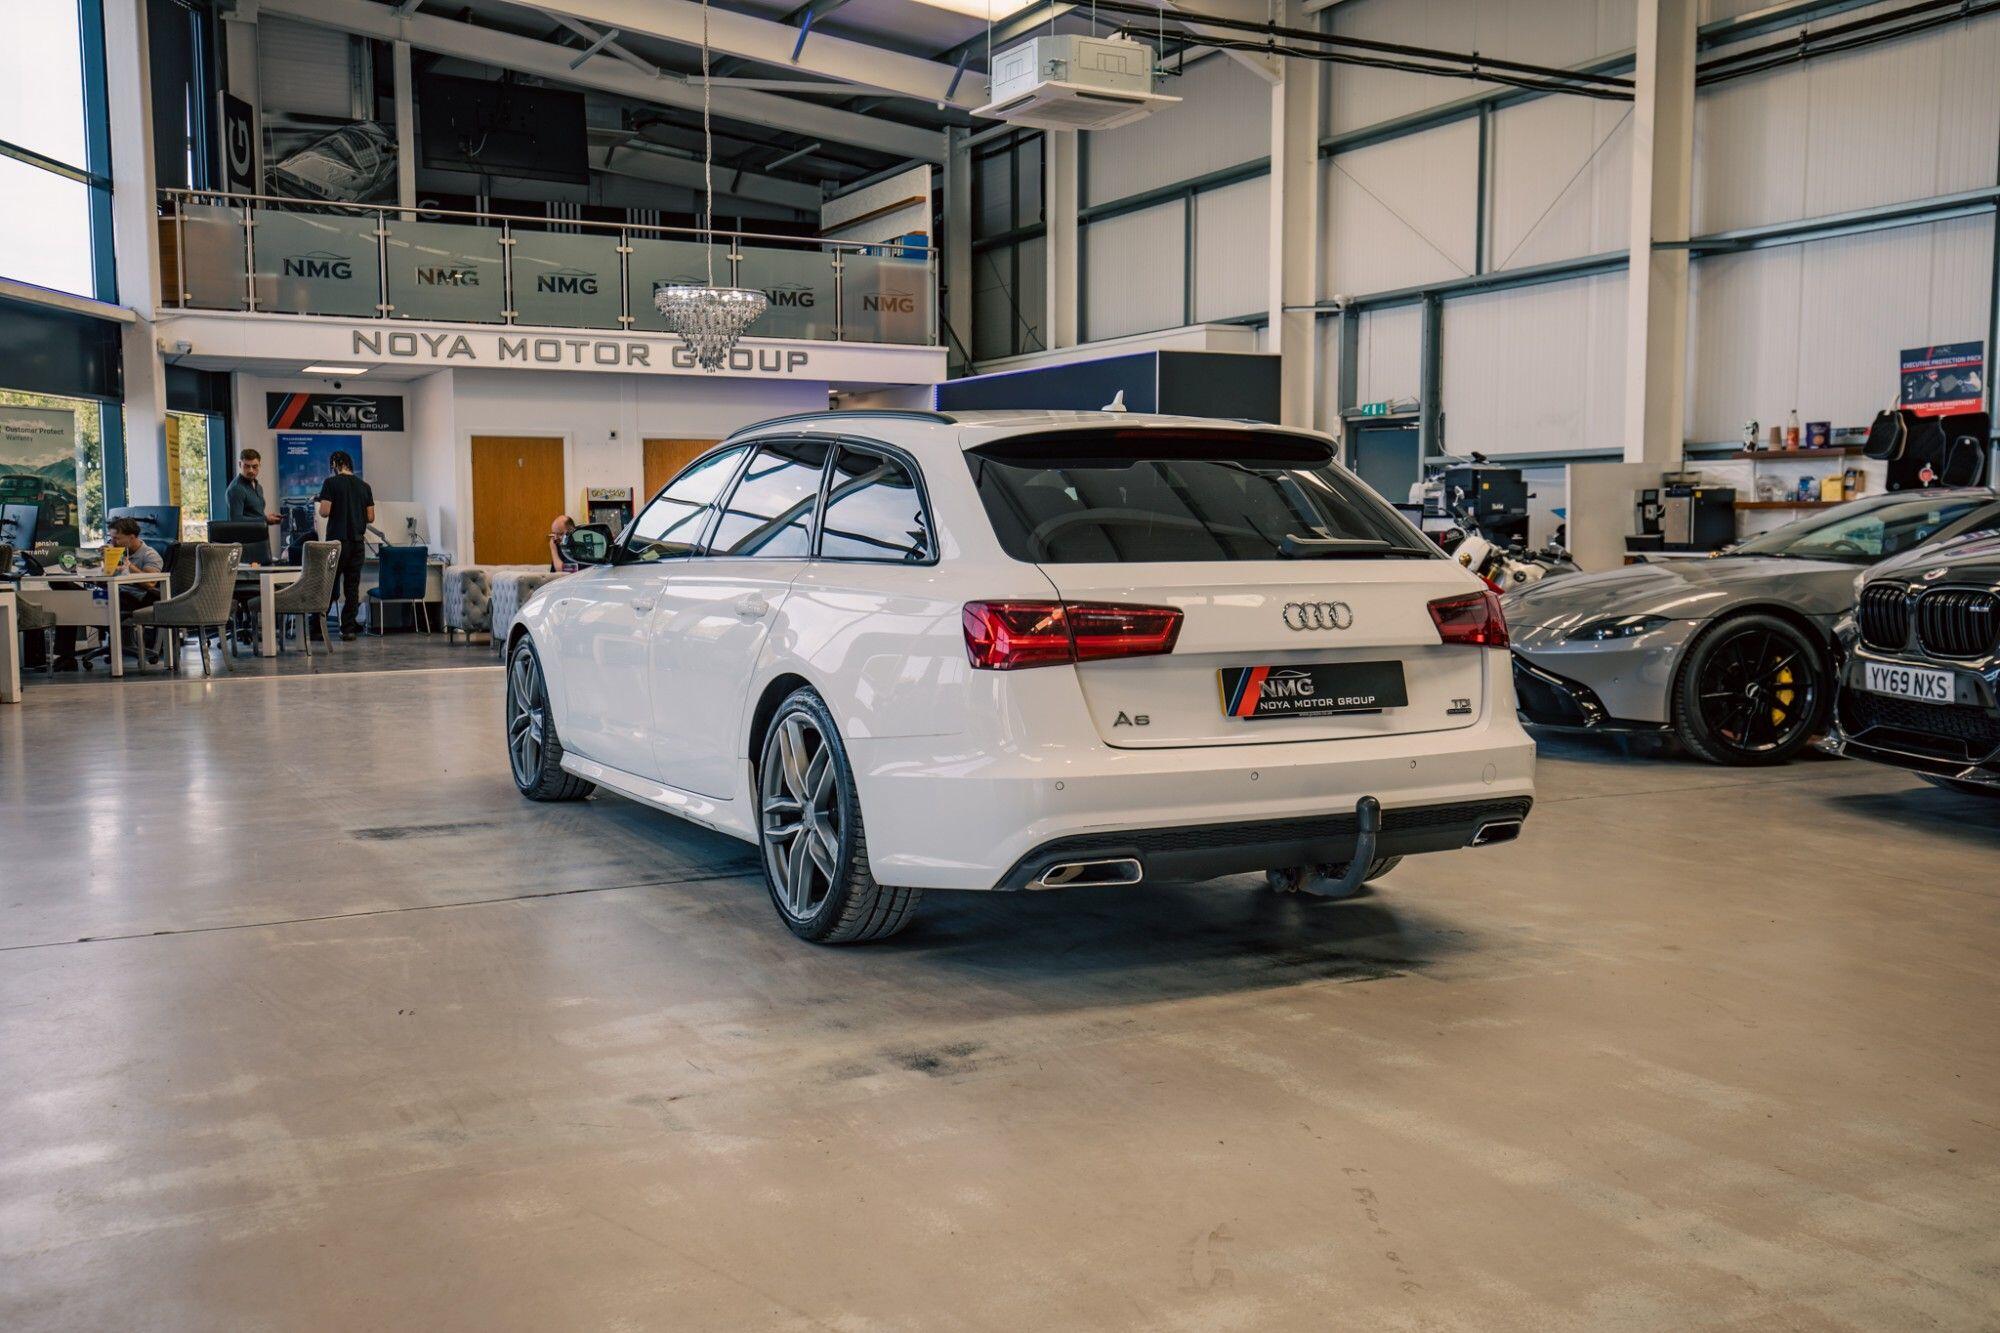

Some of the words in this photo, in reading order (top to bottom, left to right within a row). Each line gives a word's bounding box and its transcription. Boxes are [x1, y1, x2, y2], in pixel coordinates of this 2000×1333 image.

[283, 257, 352, 280] NMG
[416, 266, 480, 287] NMG
[537, 274, 598, 295] NMG
[862, 295, 915, 313] NMG
[352, 329, 477, 359] NOYA
[499, 336, 651, 367] MOTOR
[1903, 360, 1930, 369] EXECUTIVE
[1931, 356, 1966, 365] PROTECTION
[312, 404, 378, 423] NMG
[5, 425, 38, 434] Customer
[39, 427, 64, 436] Protect
[6, 434, 33, 442] Warranty
[1258, 678, 1314, 697] NMG
[1871, 667, 1909, 693] YY69
[1914, 673, 1947, 698] NXS
[1260, 701, 1290, 710] NOYA
[1295, 698, 1336, 708] MOTOR
[1338, 696, 1375, 706] GROUP
[1113, 711, 1150, 727] A6
